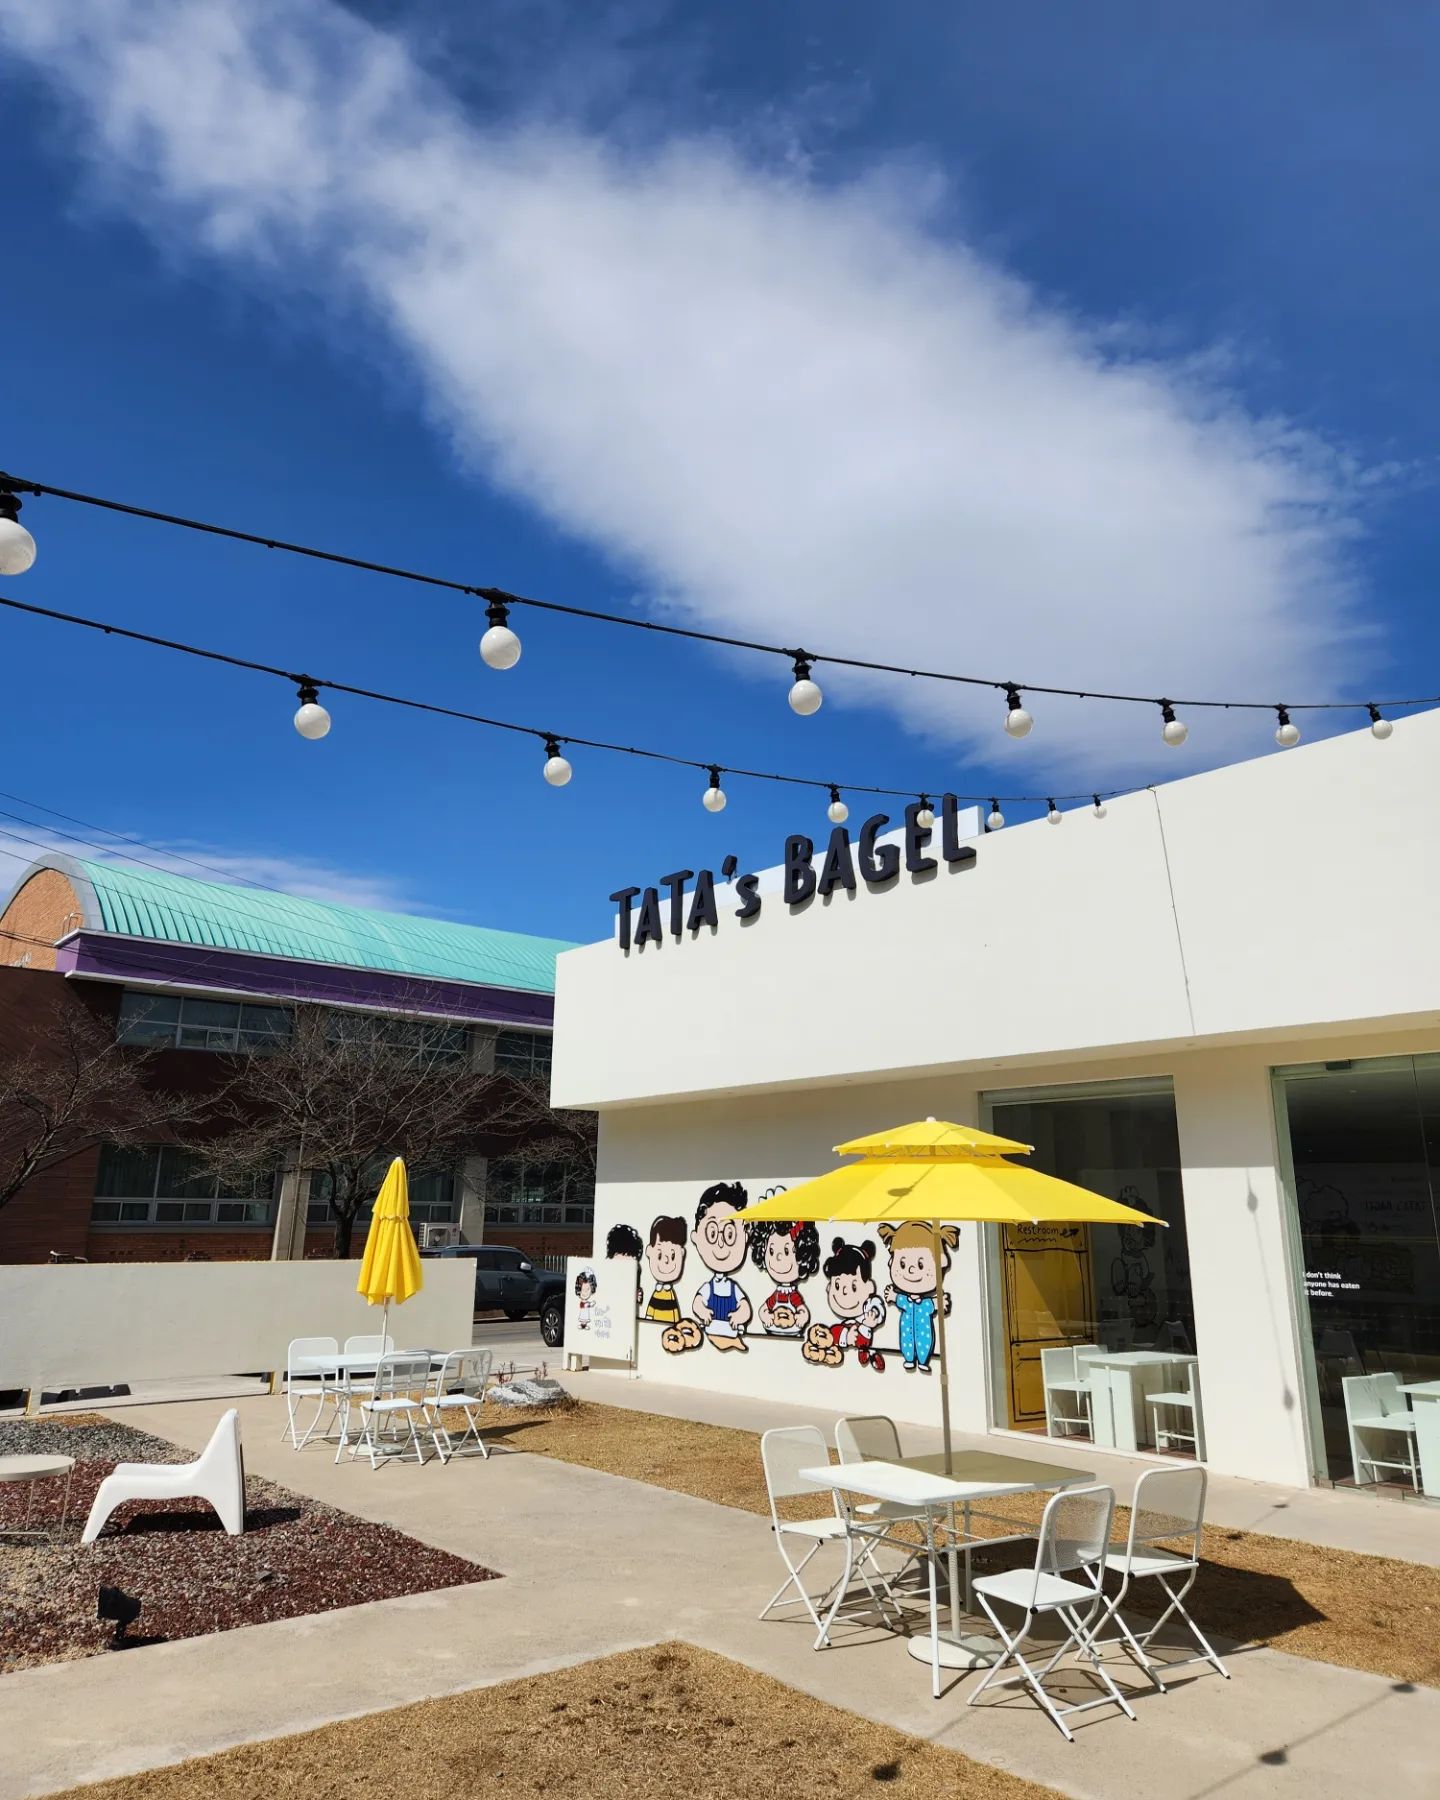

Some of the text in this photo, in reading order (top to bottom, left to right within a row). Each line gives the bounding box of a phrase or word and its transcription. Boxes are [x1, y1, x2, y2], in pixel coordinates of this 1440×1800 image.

[609, 793, 976, 950] TATA's BAGEL
[1017, 1223, 1059, 1235] Restroom
[1310, 1289, 1334, 1297] before.
